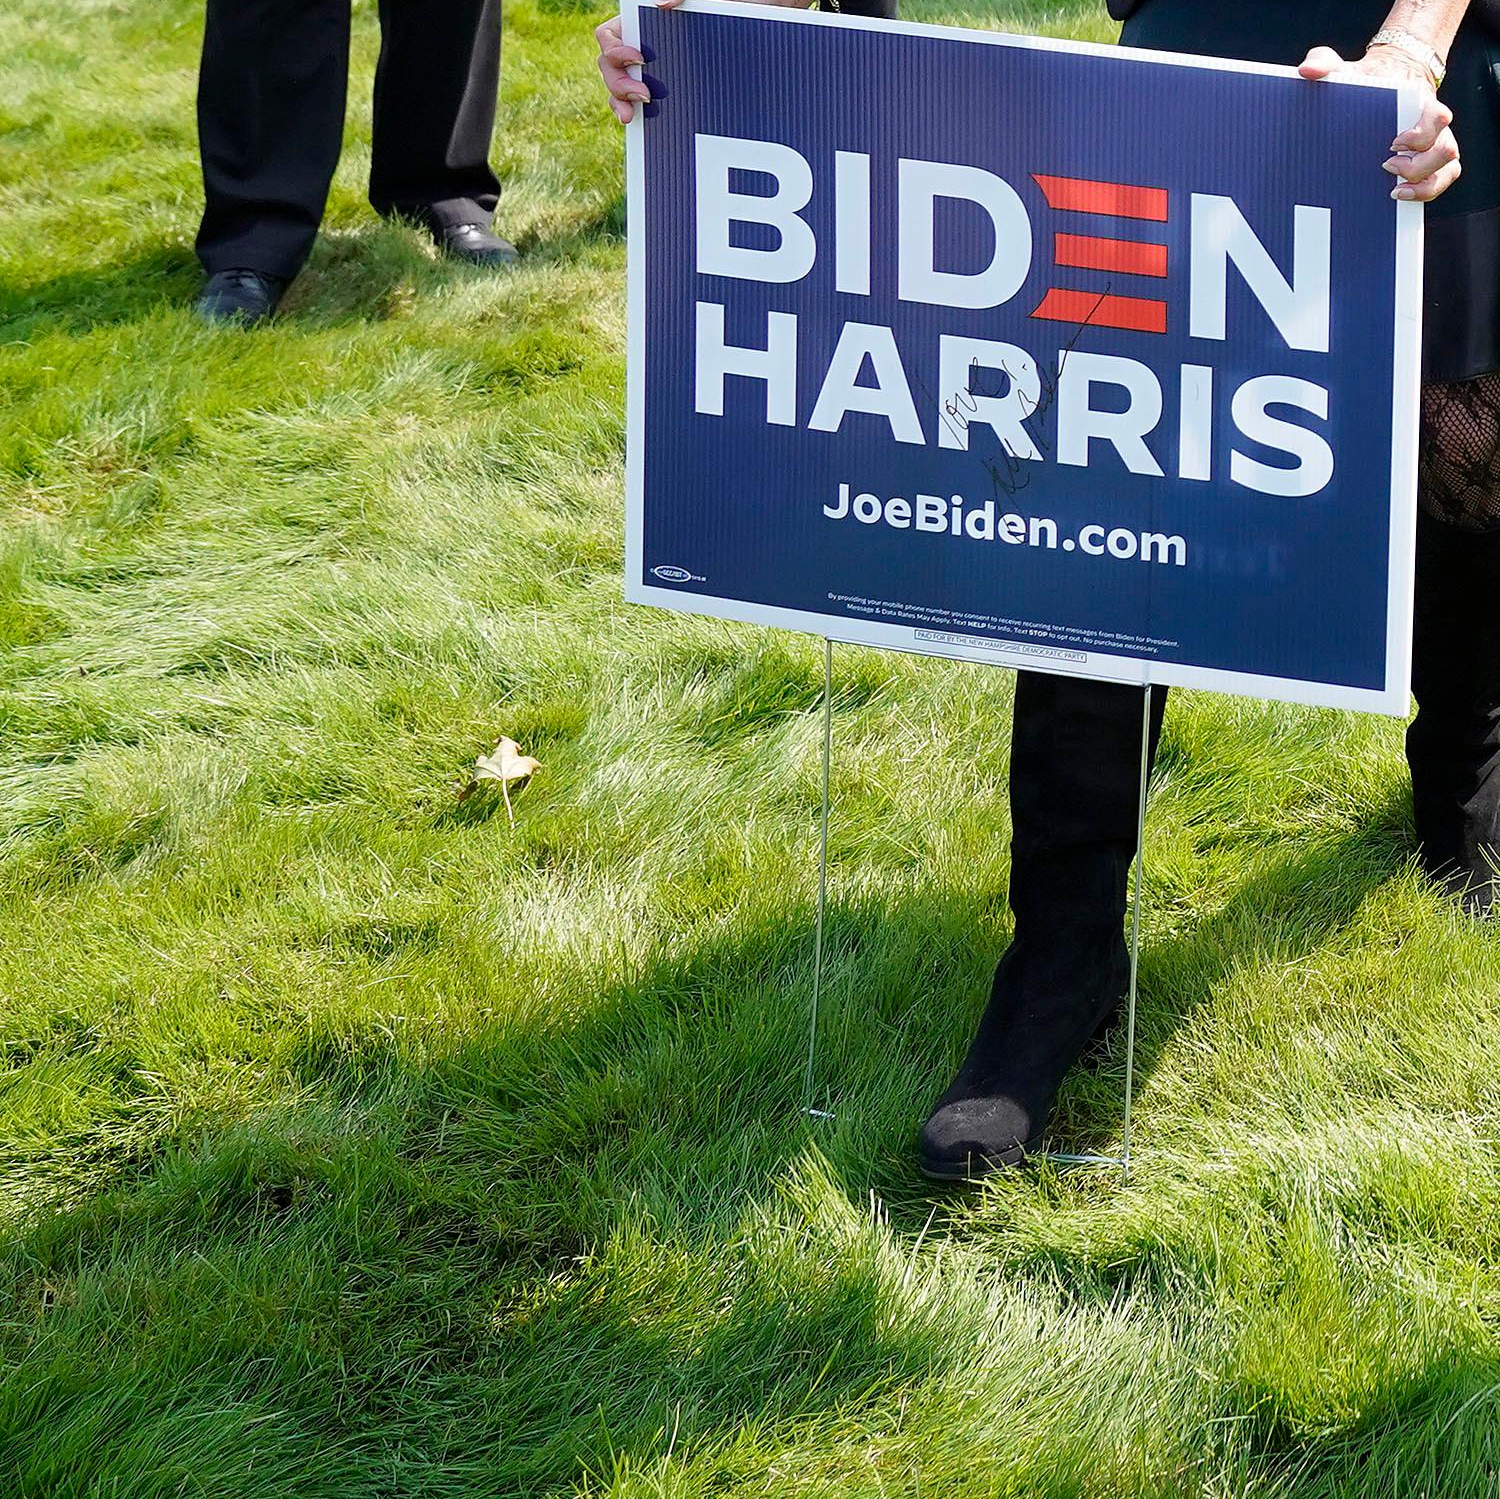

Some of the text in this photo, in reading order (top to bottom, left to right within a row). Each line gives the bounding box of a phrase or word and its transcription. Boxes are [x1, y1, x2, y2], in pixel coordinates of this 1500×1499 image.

[694, 132, 1333, 354] BIDEN
[694, 302, 1336, 498] HARRIS
[823, 483, 1188, 567] JoeBiden.com
